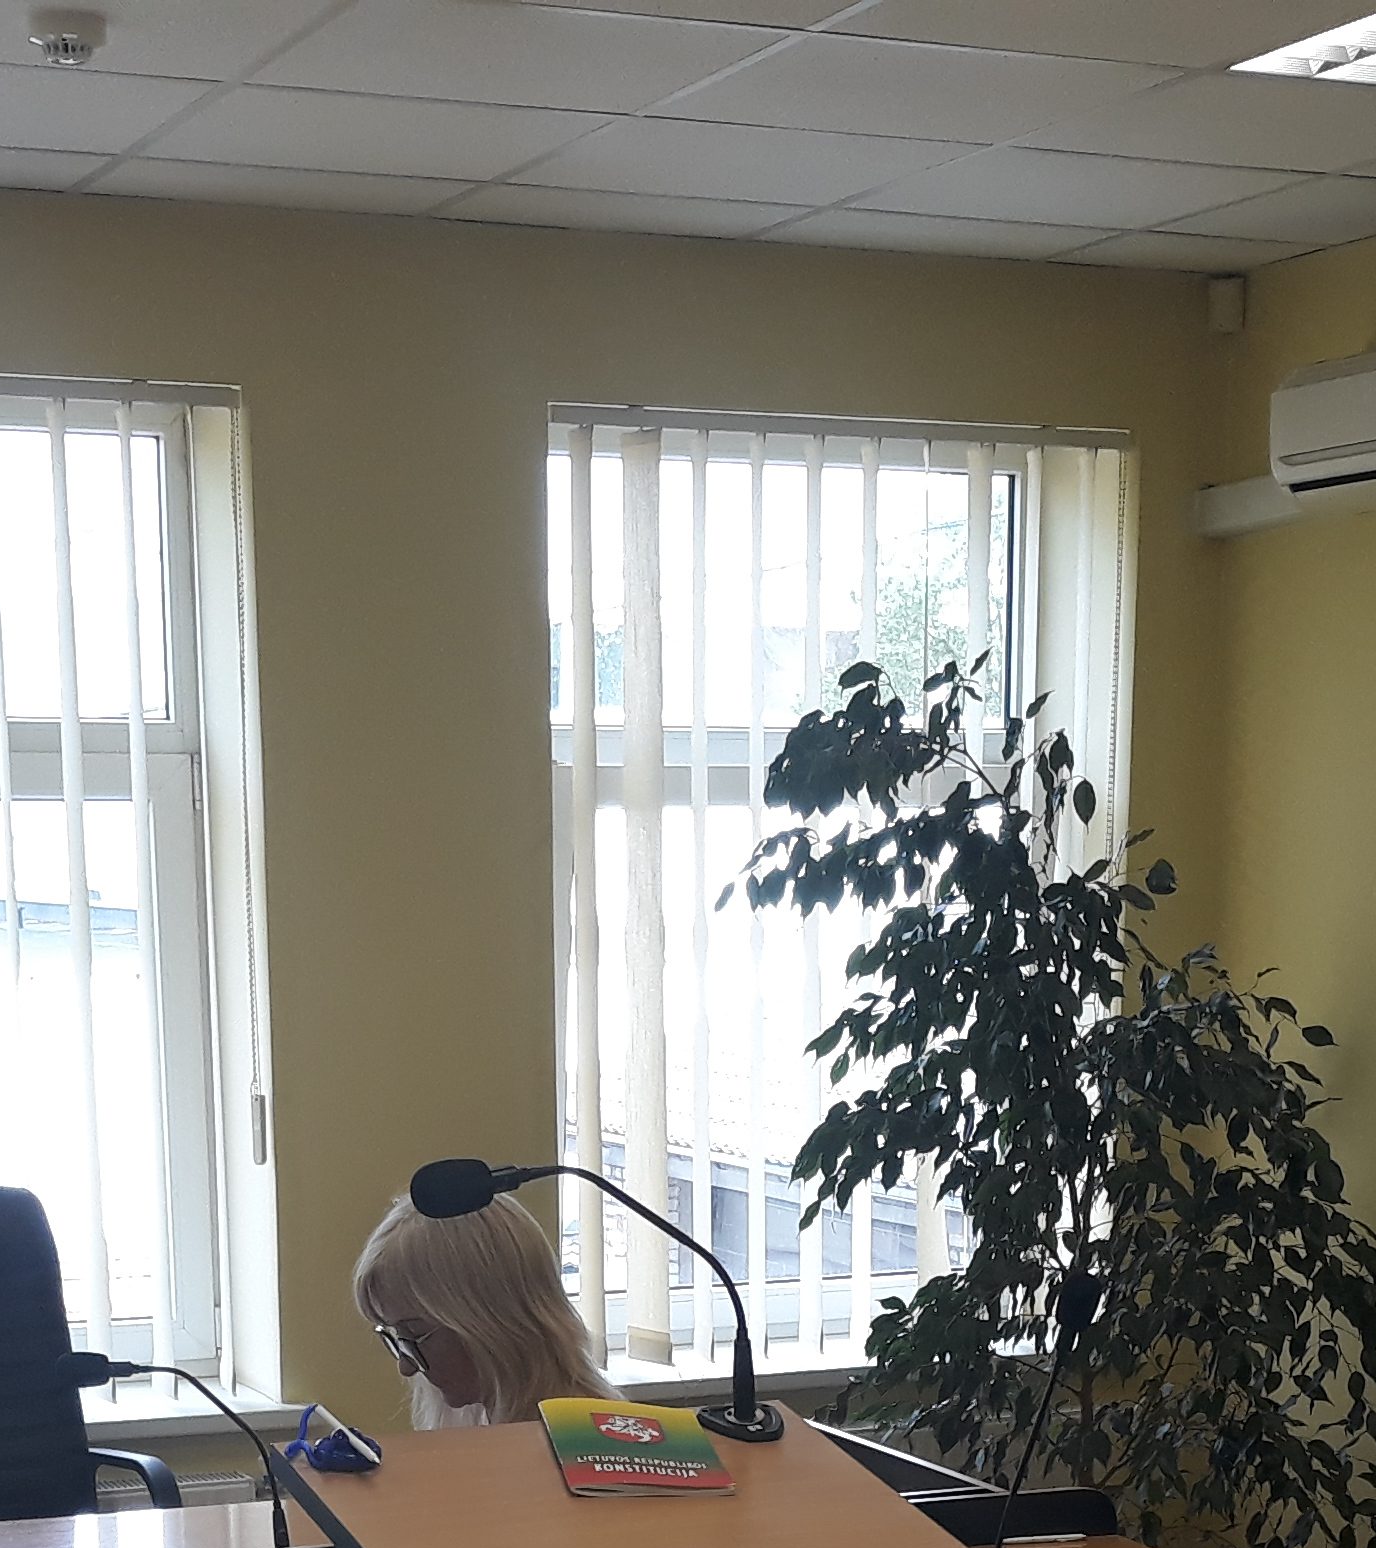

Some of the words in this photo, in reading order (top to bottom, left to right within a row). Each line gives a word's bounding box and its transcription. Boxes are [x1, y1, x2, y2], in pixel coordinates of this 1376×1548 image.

[577, 1455, 631, 1464] LIETUVOS
[633, 1456, 707, 1469] RESPUBLIKOS
[594, 1463, 699, 1478] KONSTITUCIJA
